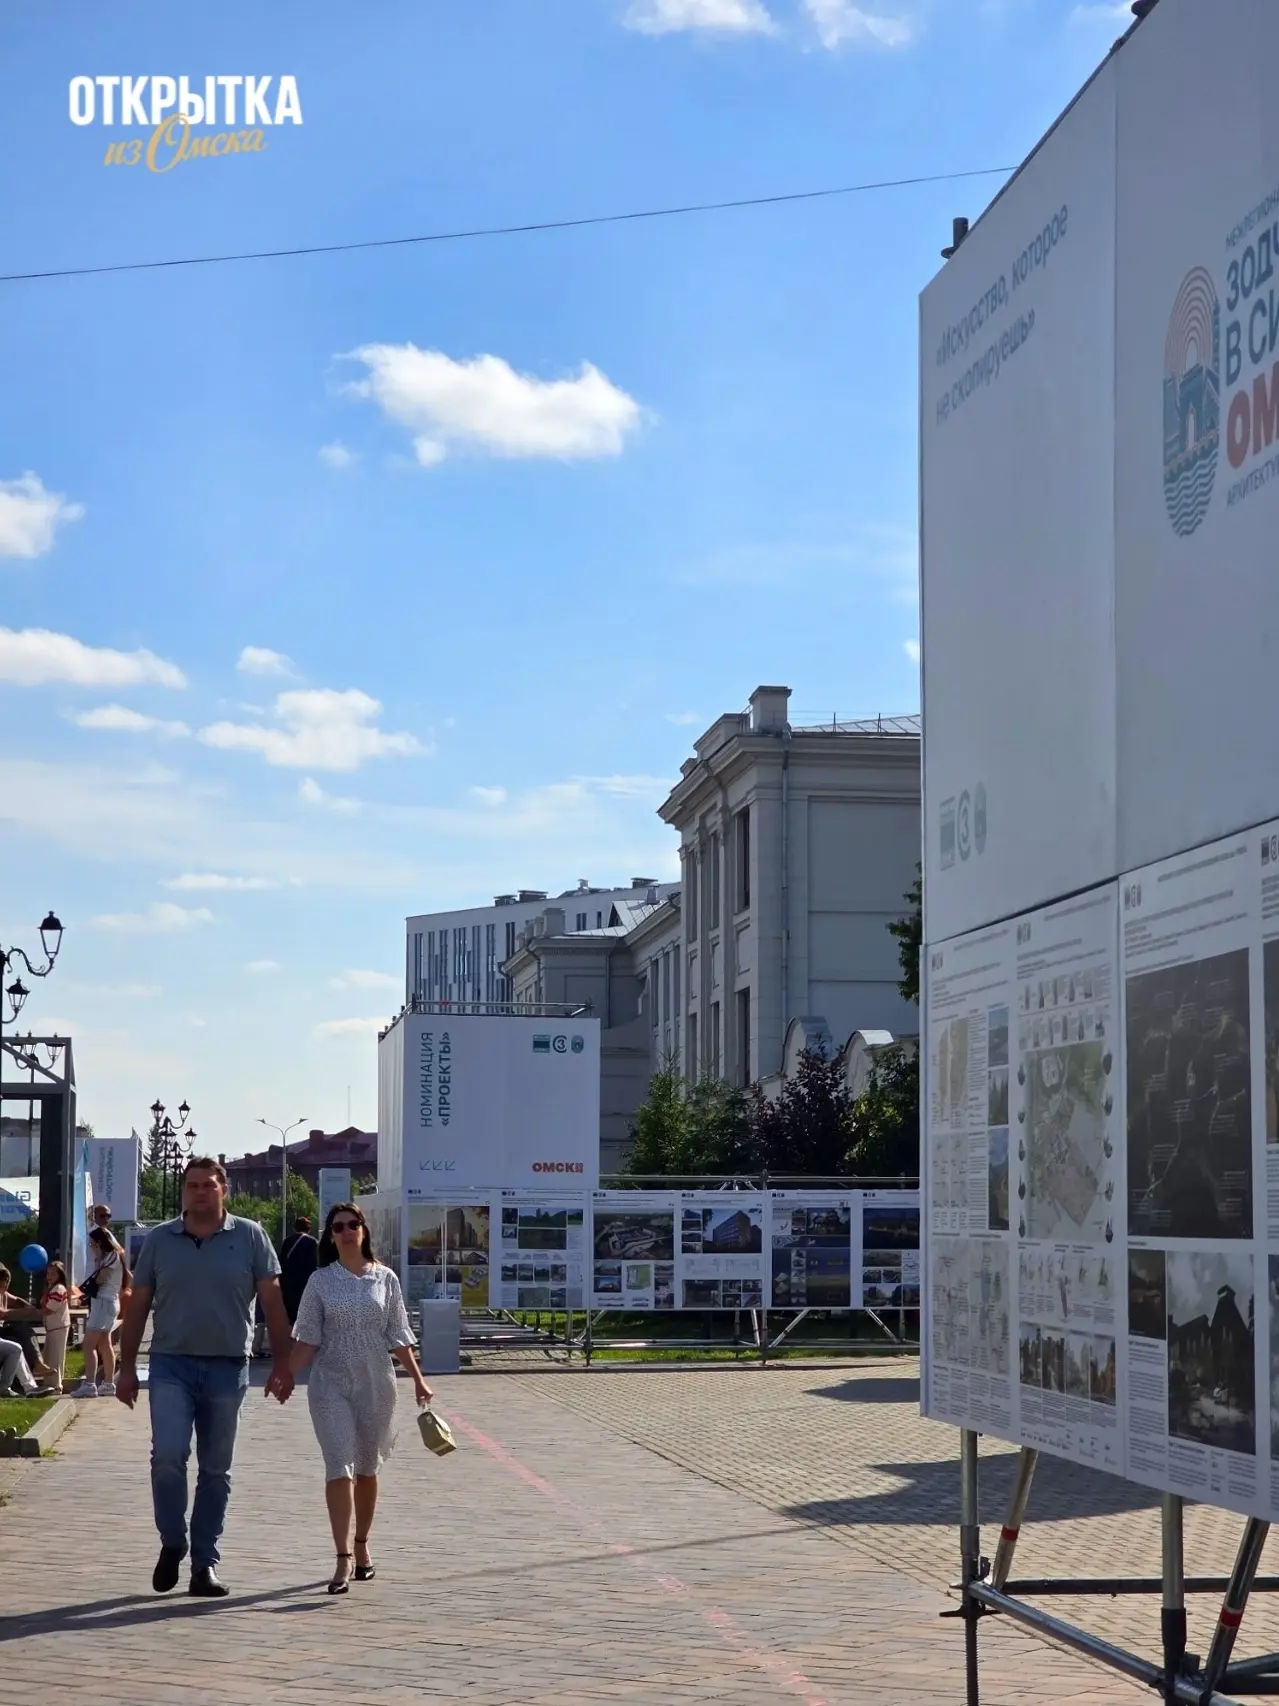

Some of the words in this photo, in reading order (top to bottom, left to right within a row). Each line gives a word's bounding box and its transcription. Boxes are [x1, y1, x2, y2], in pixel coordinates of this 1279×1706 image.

[936, 274, 1009, 367] «Искусство,
[1012, 204, 1068, 292] которое
[936, 391, 950, 426] не
[951, 307, 1036, 411] скопируешь»
[1226, 319, 1242, 389] В
[420, 1032, 434, 1128] НОМИНАЦИЯ
[438, 1031, 451, 1126] «ПРОЕКТЫ»
[532, 1162, 575, 1173] ОМСК
